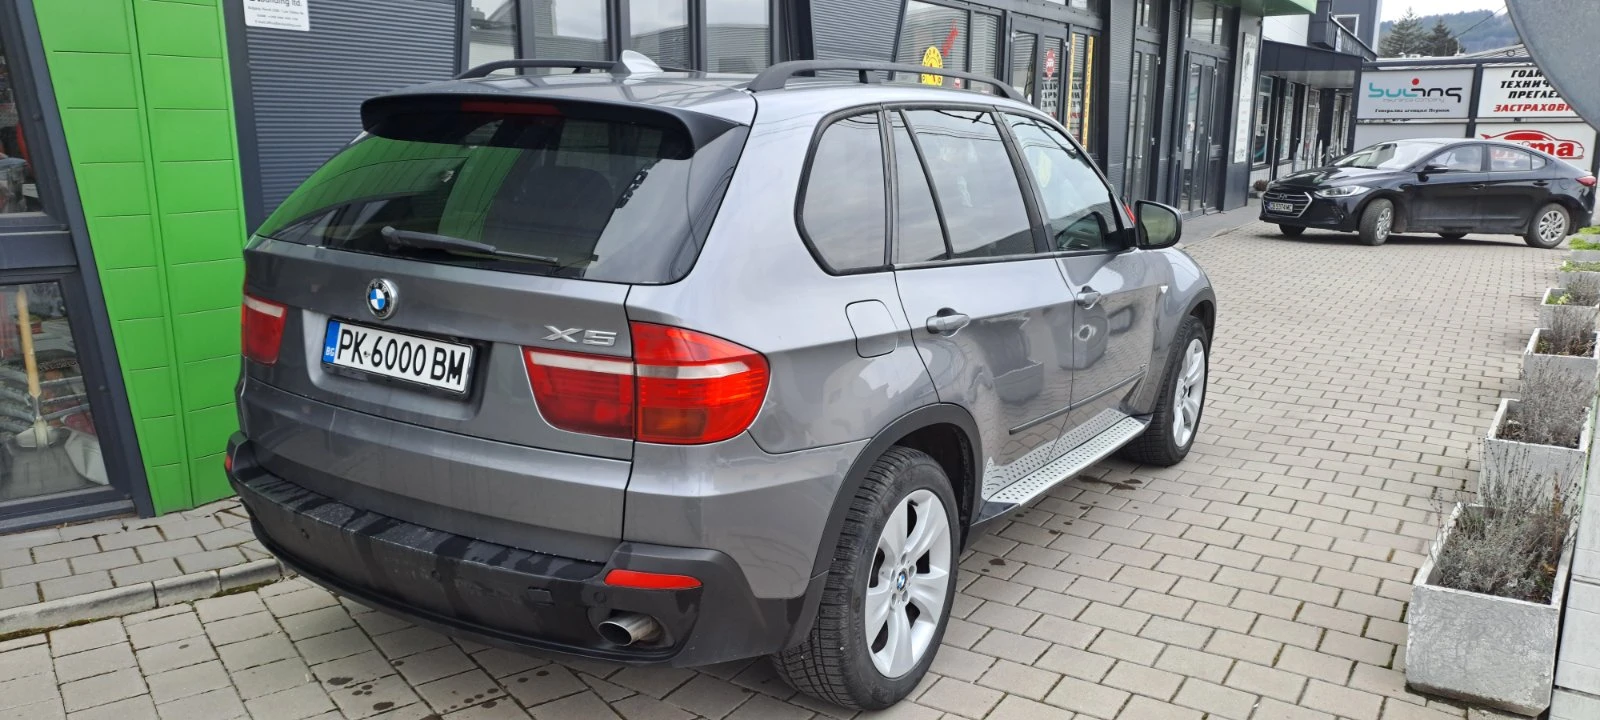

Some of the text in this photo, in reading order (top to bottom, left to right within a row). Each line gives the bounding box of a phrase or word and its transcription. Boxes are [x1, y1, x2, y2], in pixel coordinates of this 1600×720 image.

[541, 325, 617, 346] X5
[337, 329, 466, 385] PK 6000 BM
